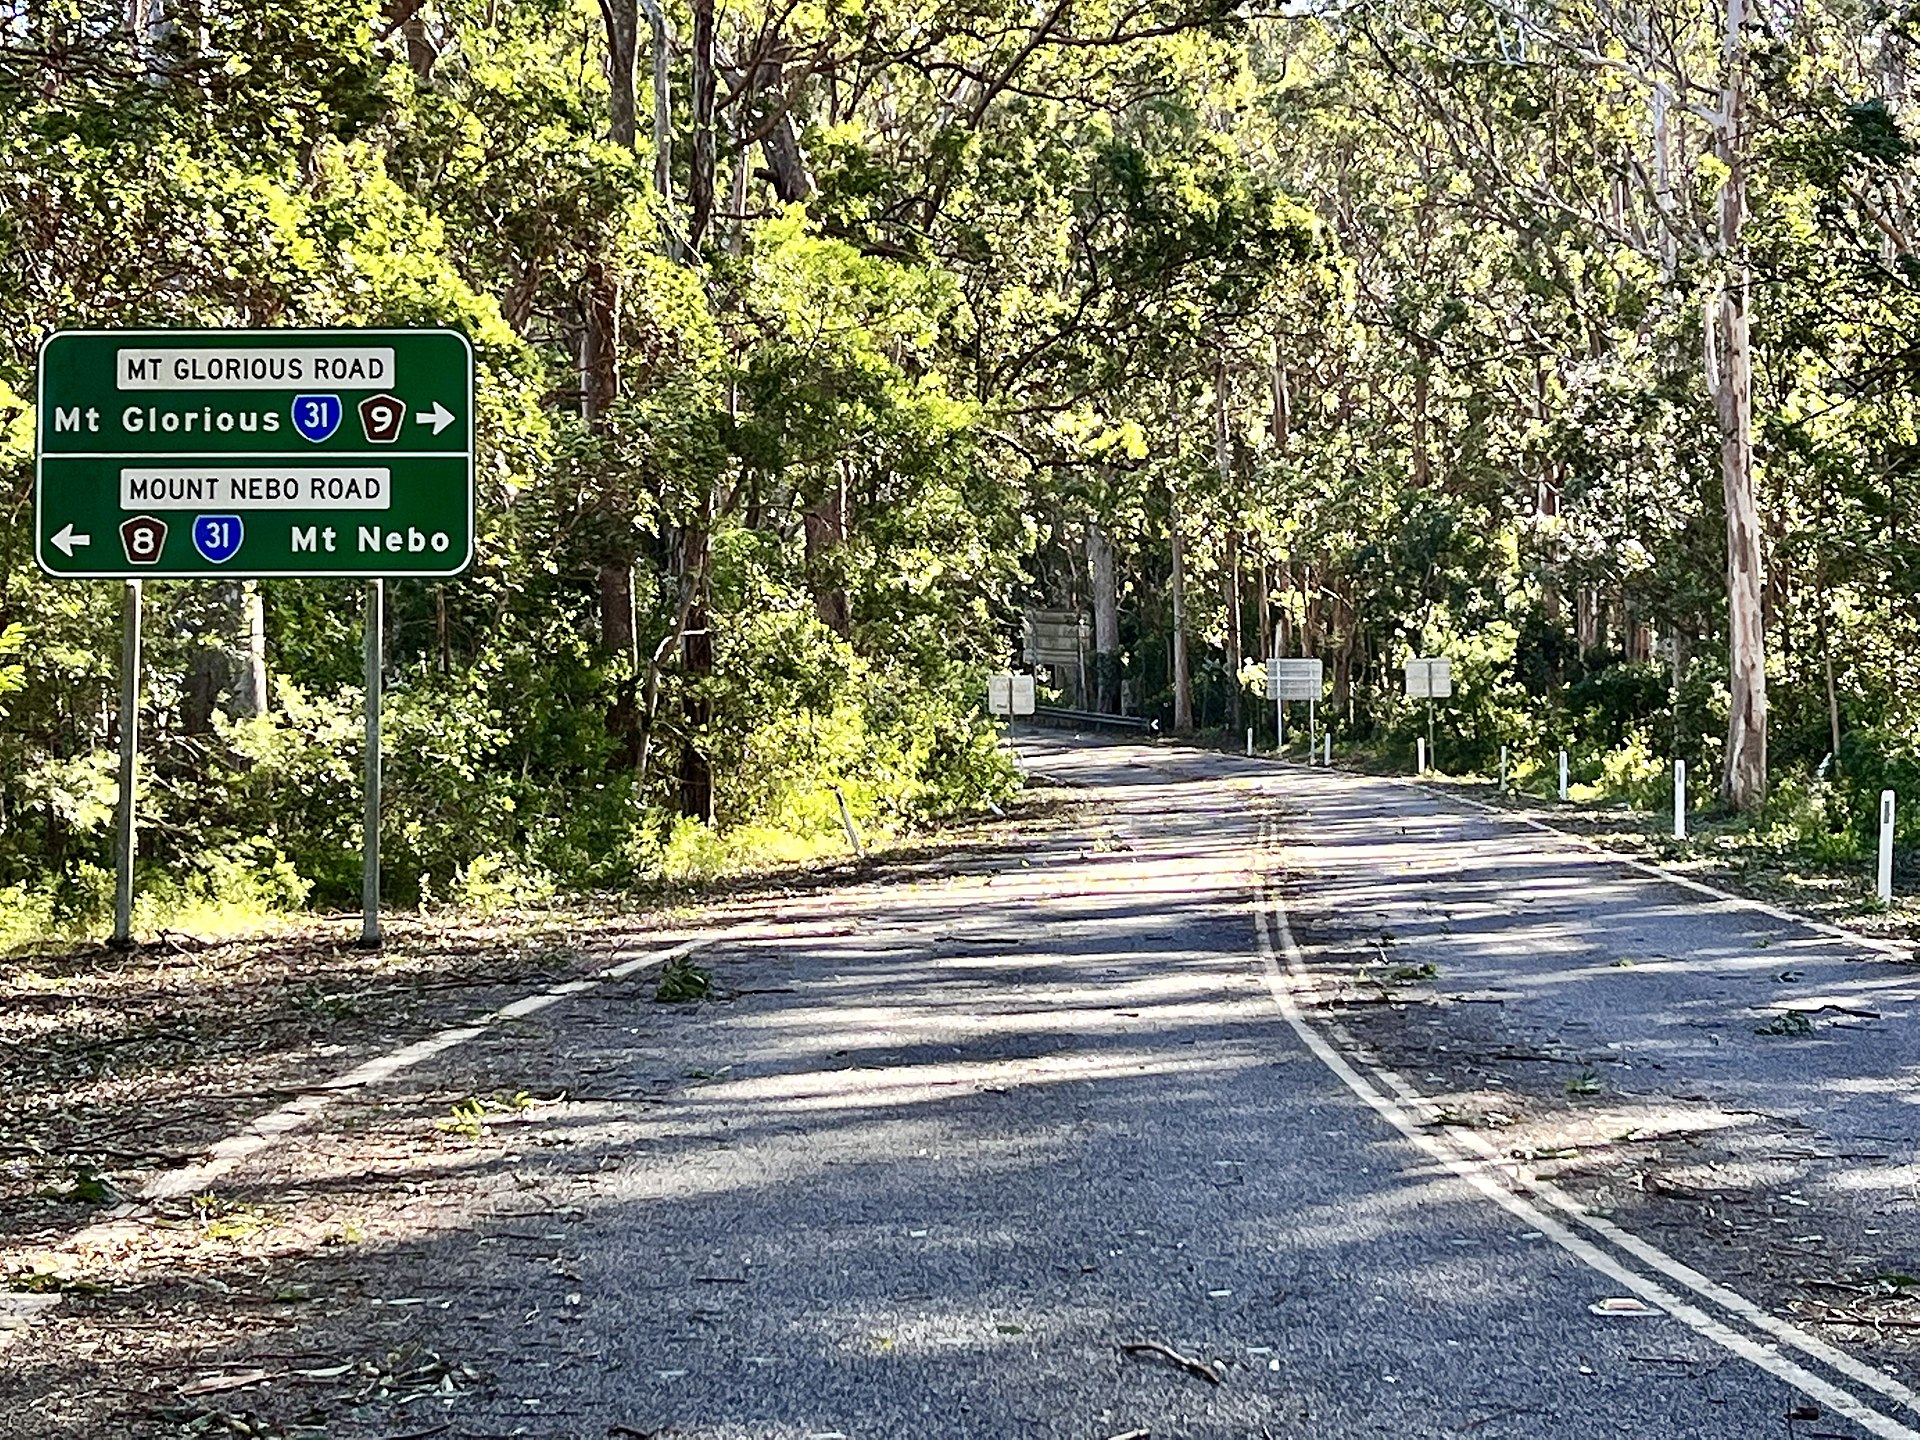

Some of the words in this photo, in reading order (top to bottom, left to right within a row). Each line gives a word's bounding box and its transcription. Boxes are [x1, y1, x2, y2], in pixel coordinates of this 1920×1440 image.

[128, 358, 162, 380] MT
[174, 358, 302, 380] GLORIOUS
[314, 358, 384, 380] ROAD
[54, 407, 100, 432] Mt
[122, 406, 280, 432] Glorious
[304, 402, 328, 427] 31
[371, 406, 392, 432] 9
[130, 478, 219, 500] MOUNT
[231, 478, 299, 499] NEBO
[311, 478, 380, 499] ROAD
[133, 528, 154, 552] 8
[205, 523, 229, 548] 31
[291, 526, 336, 552] Mt
[359, 526, 449, 552] Nebo
